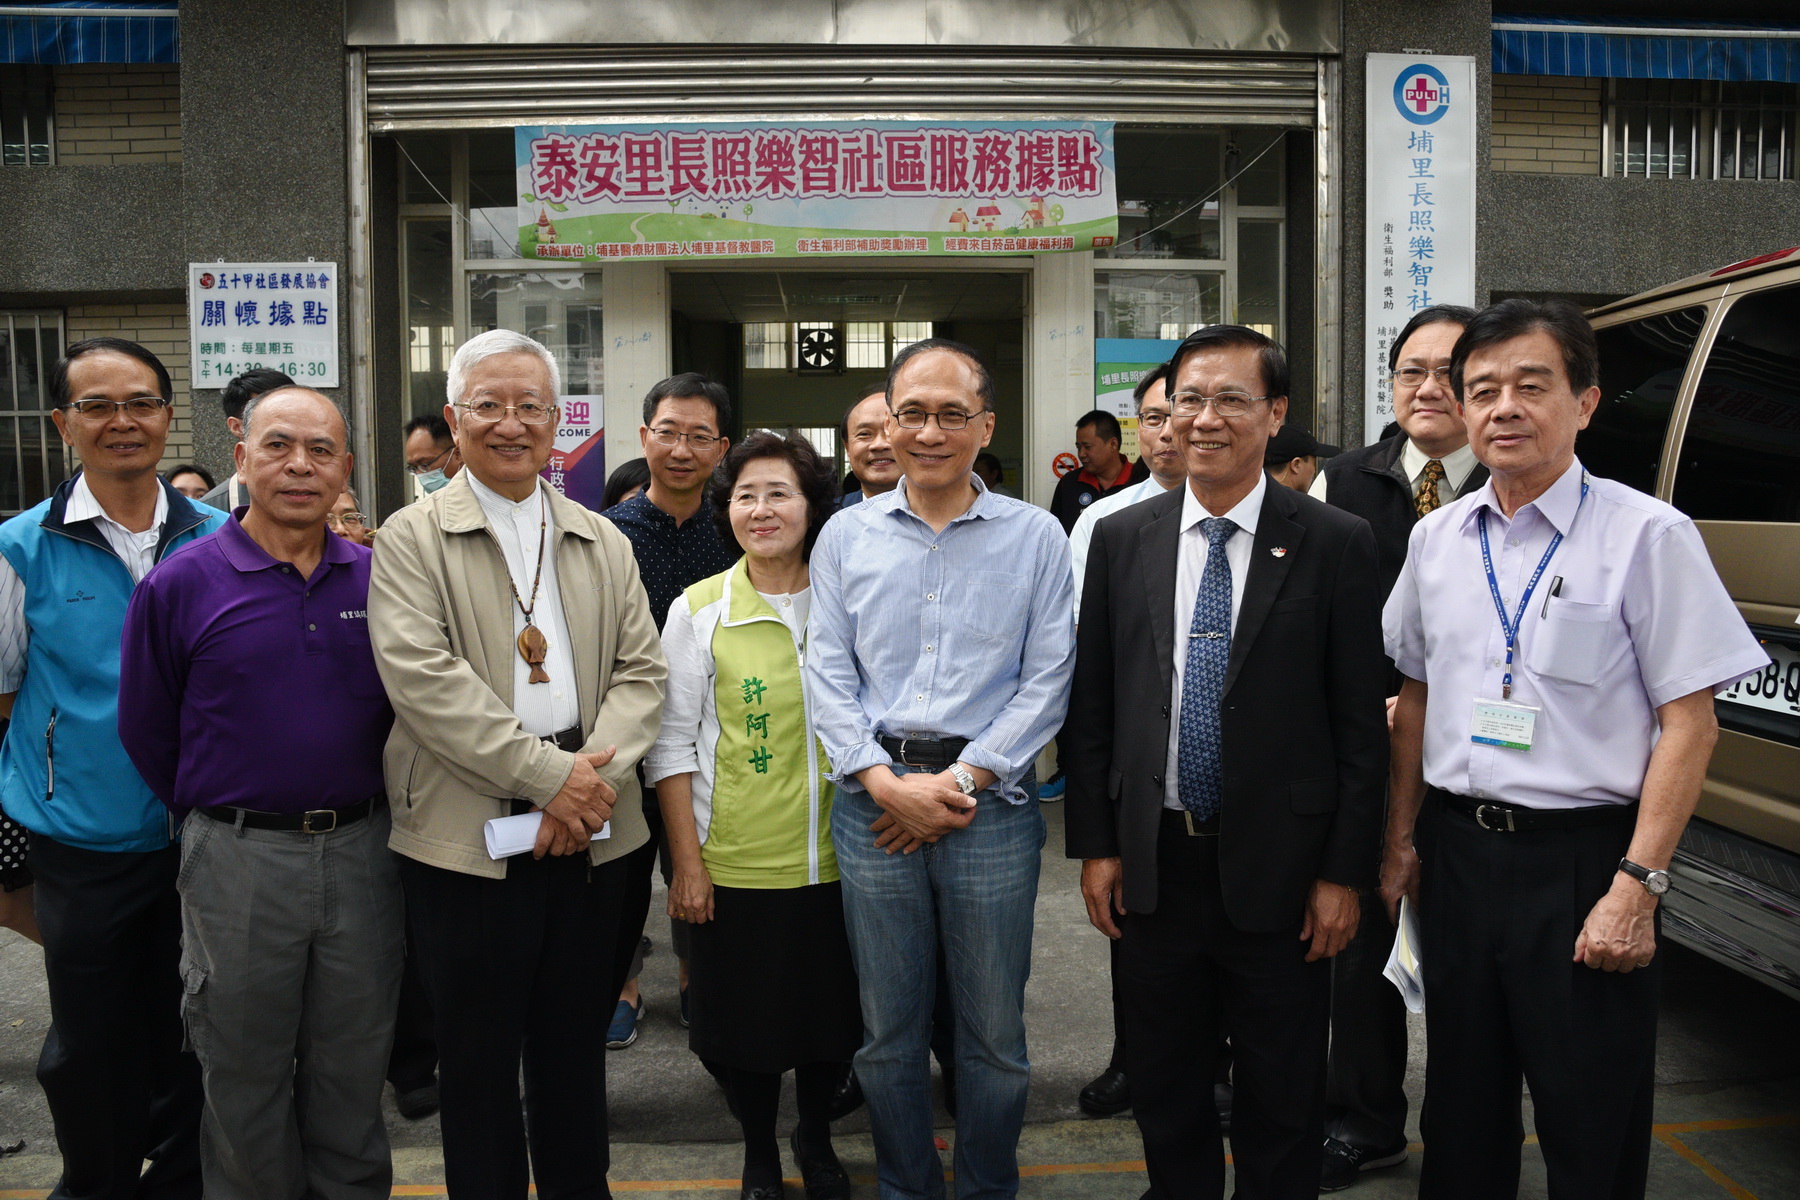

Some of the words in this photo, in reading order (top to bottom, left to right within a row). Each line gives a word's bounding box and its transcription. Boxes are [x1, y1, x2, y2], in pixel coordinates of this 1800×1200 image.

[1407, 90, 1436, 100] PULI
[536, 133, 1097, 198] 泰安里長照樂智社區服務據點
[1407, 129, 1435, 321] 埔里長照樂智社
[1383, 222, 1394, 277] 衛生福利部
[217, 272, 330, 290] 五十甲社區發展協會
[1383, 286, 1394, 311] 獎助
[201, 300, 328, 327] 關懷據點
[1376, 326, 1387, 415] 埔里基督教醫院
[565, 401, 590, 425] 迎
[555, 428, 591, 437] COME
[740, 676, 773, 774] 許阿甘
